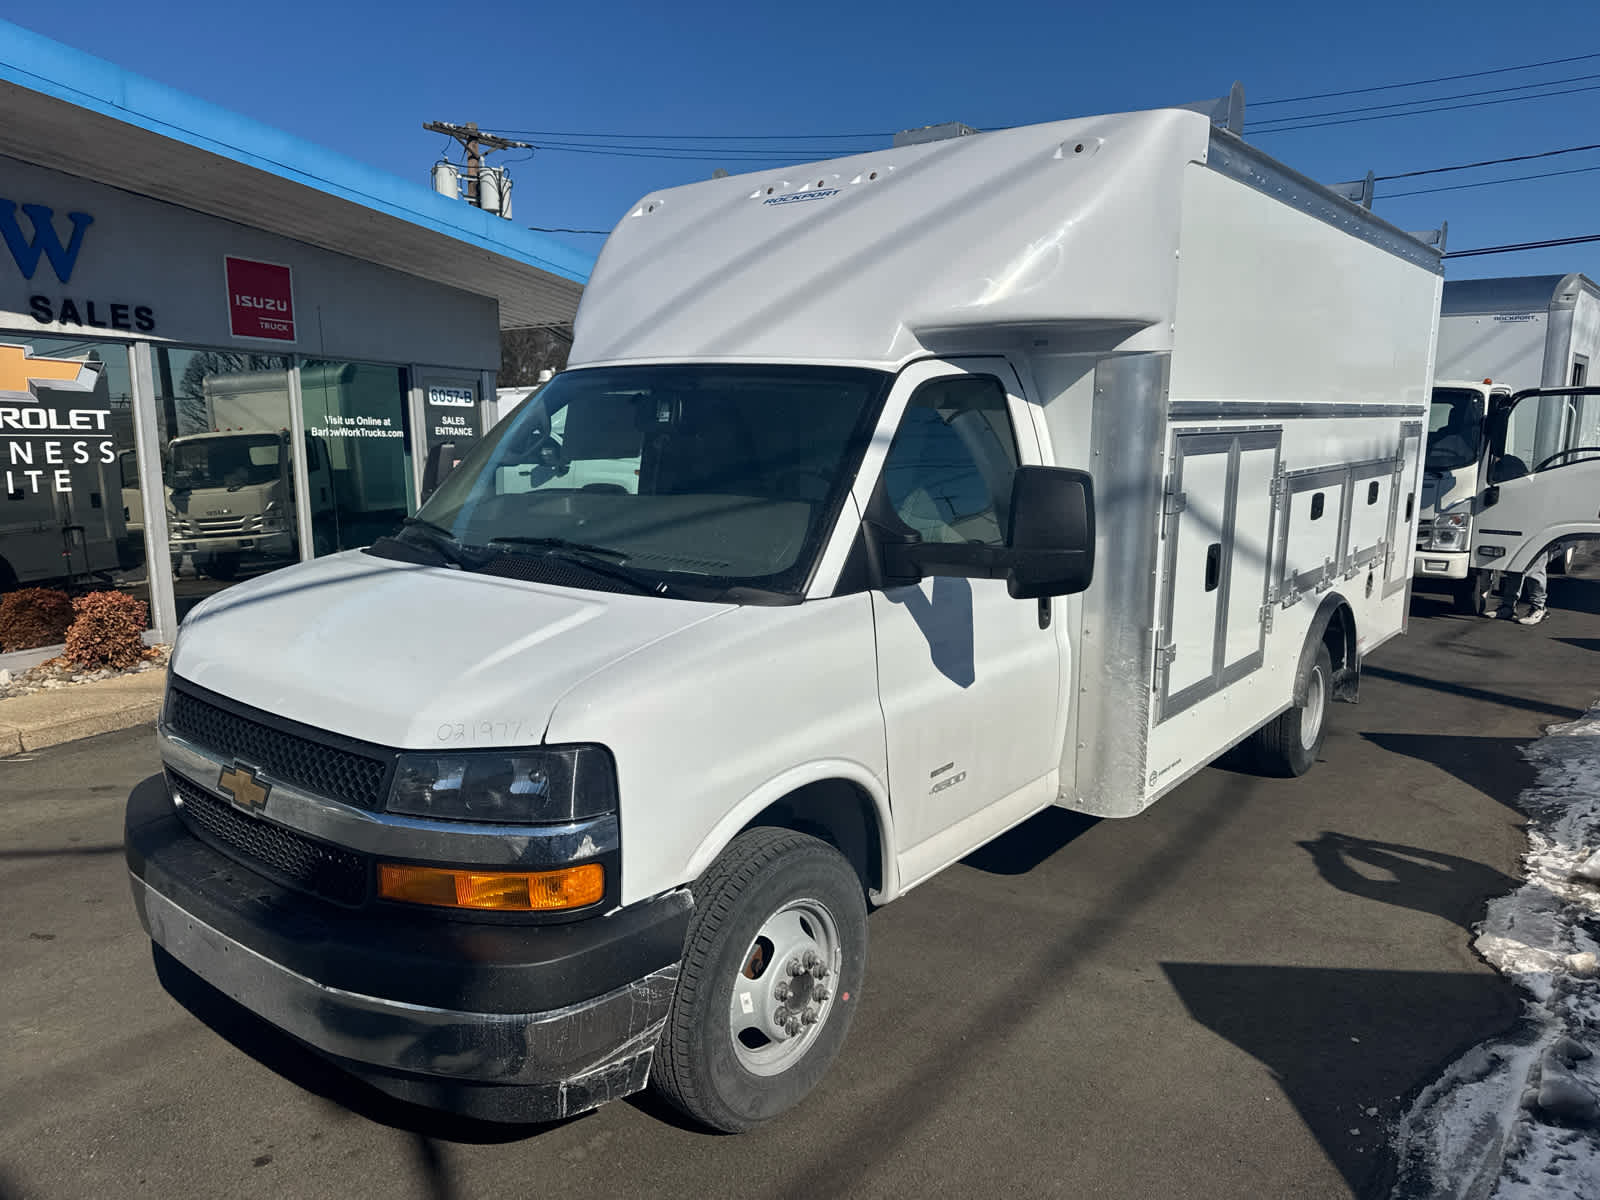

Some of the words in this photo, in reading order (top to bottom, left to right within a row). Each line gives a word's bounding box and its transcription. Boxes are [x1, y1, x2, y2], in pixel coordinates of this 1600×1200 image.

[763, 189, 842, 205] ROCKPORT
[0, 199, 95, 284] W
[234, 293, 288, 312] ISUZU
[29, 295, 155, 331] SALES
[259, 321, 289, 332] TRUCK
[430, 388, 473, 404] 6057-B
[324, 415, 343, 425] Visit
[344, 417, 355, 426] us
[356, 416, 382, 426] Online
[383, 417, 391, 426] at
[441, 416, 465, 426] SALES
[311, 427, 404, 438] BarlowWorkTrucks.com
[434, 426, 473, 437] ENTRANCE
[9, 440, 115, 465] NESS
